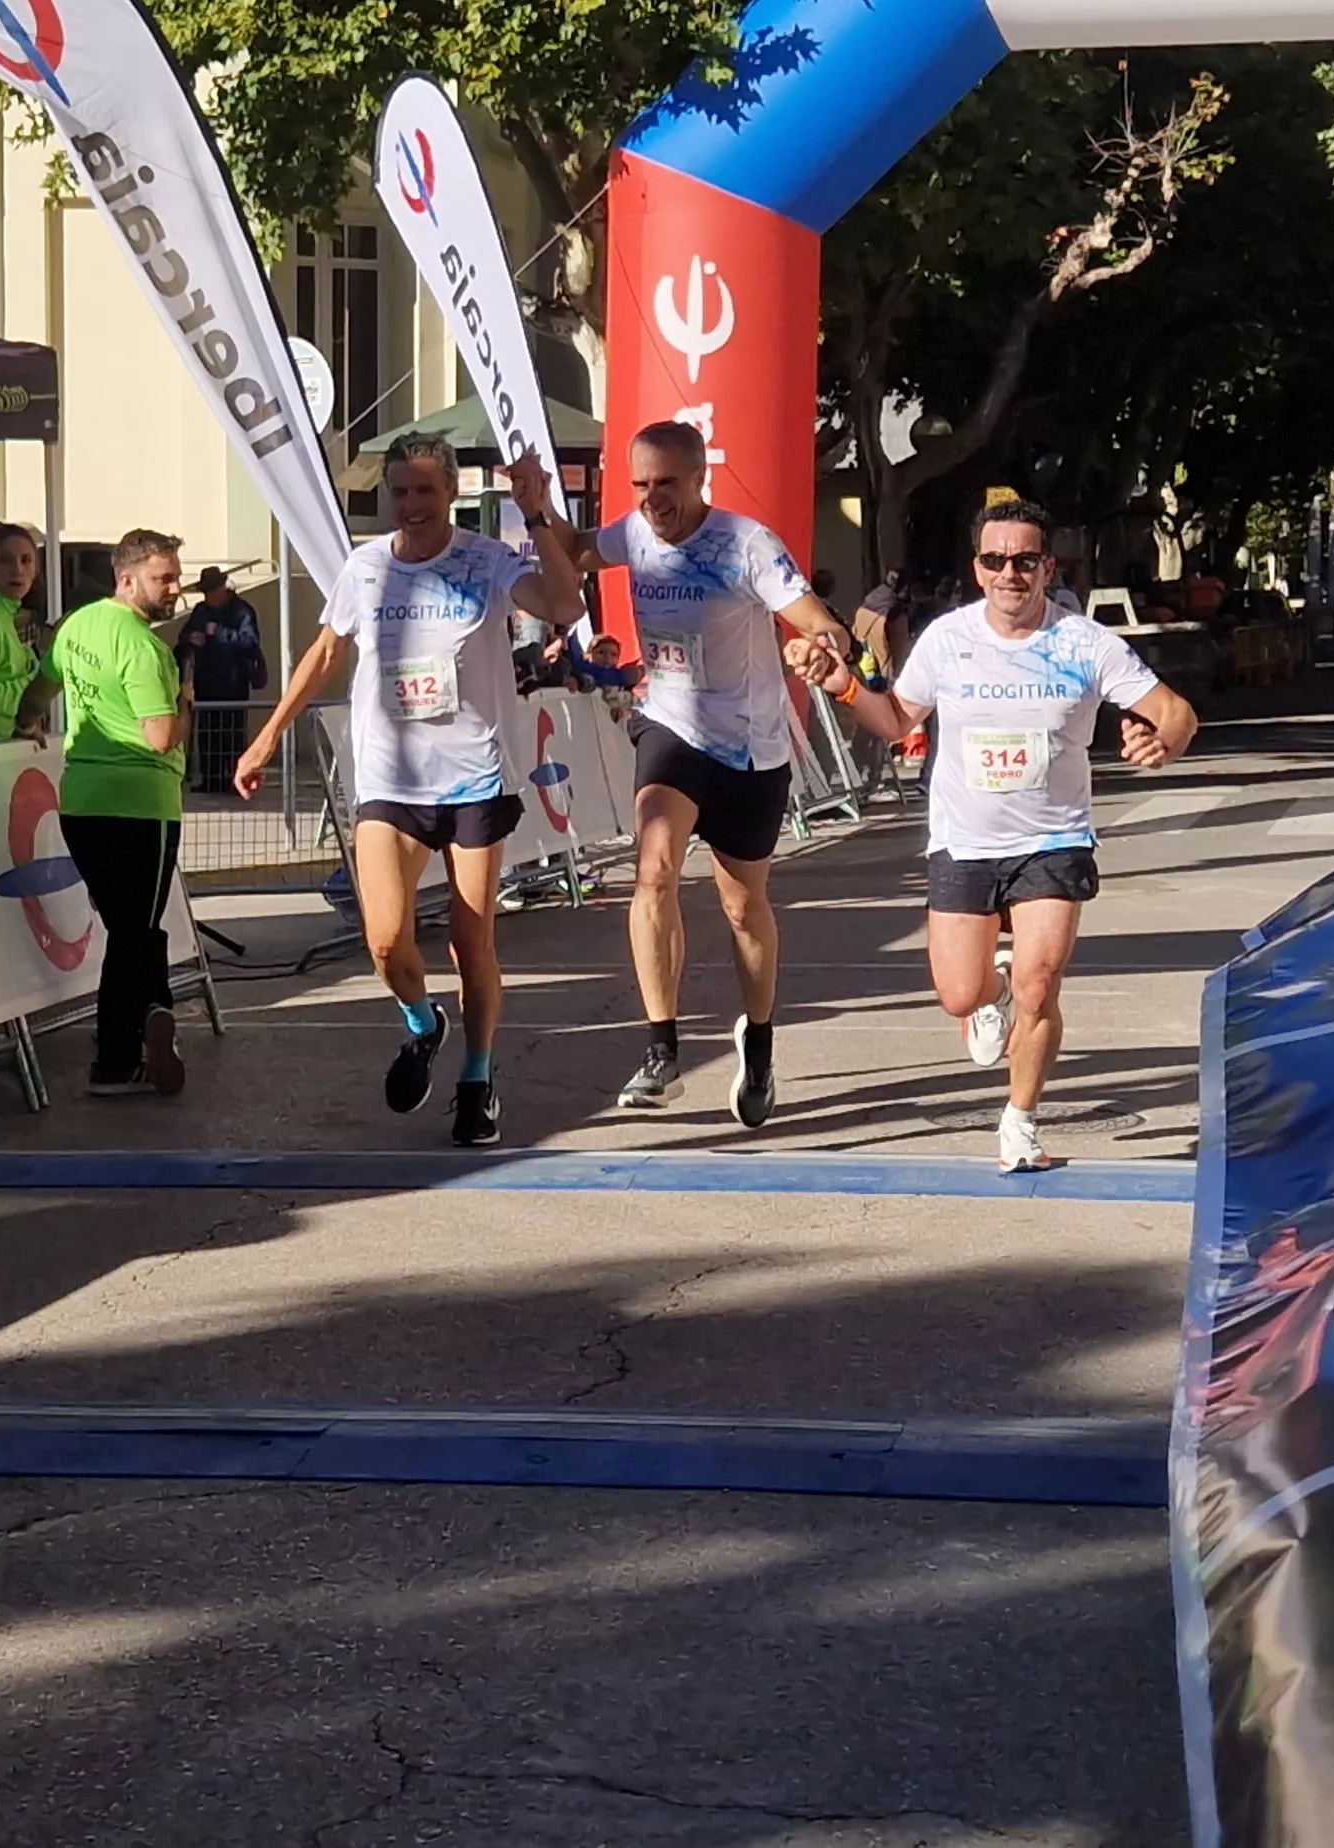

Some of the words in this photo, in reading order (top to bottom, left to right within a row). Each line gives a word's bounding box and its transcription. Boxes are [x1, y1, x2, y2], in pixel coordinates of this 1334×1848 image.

[638, 584, 704, 602] COGITIAR
[385, 604, 465, 621] COGITIAR
[648, 643, 685, 664] 313
[394, 676, 437, 699] 312
[978, 682, 1067, 700] COGITIAR
[980, 748, 1029, 768] 314
